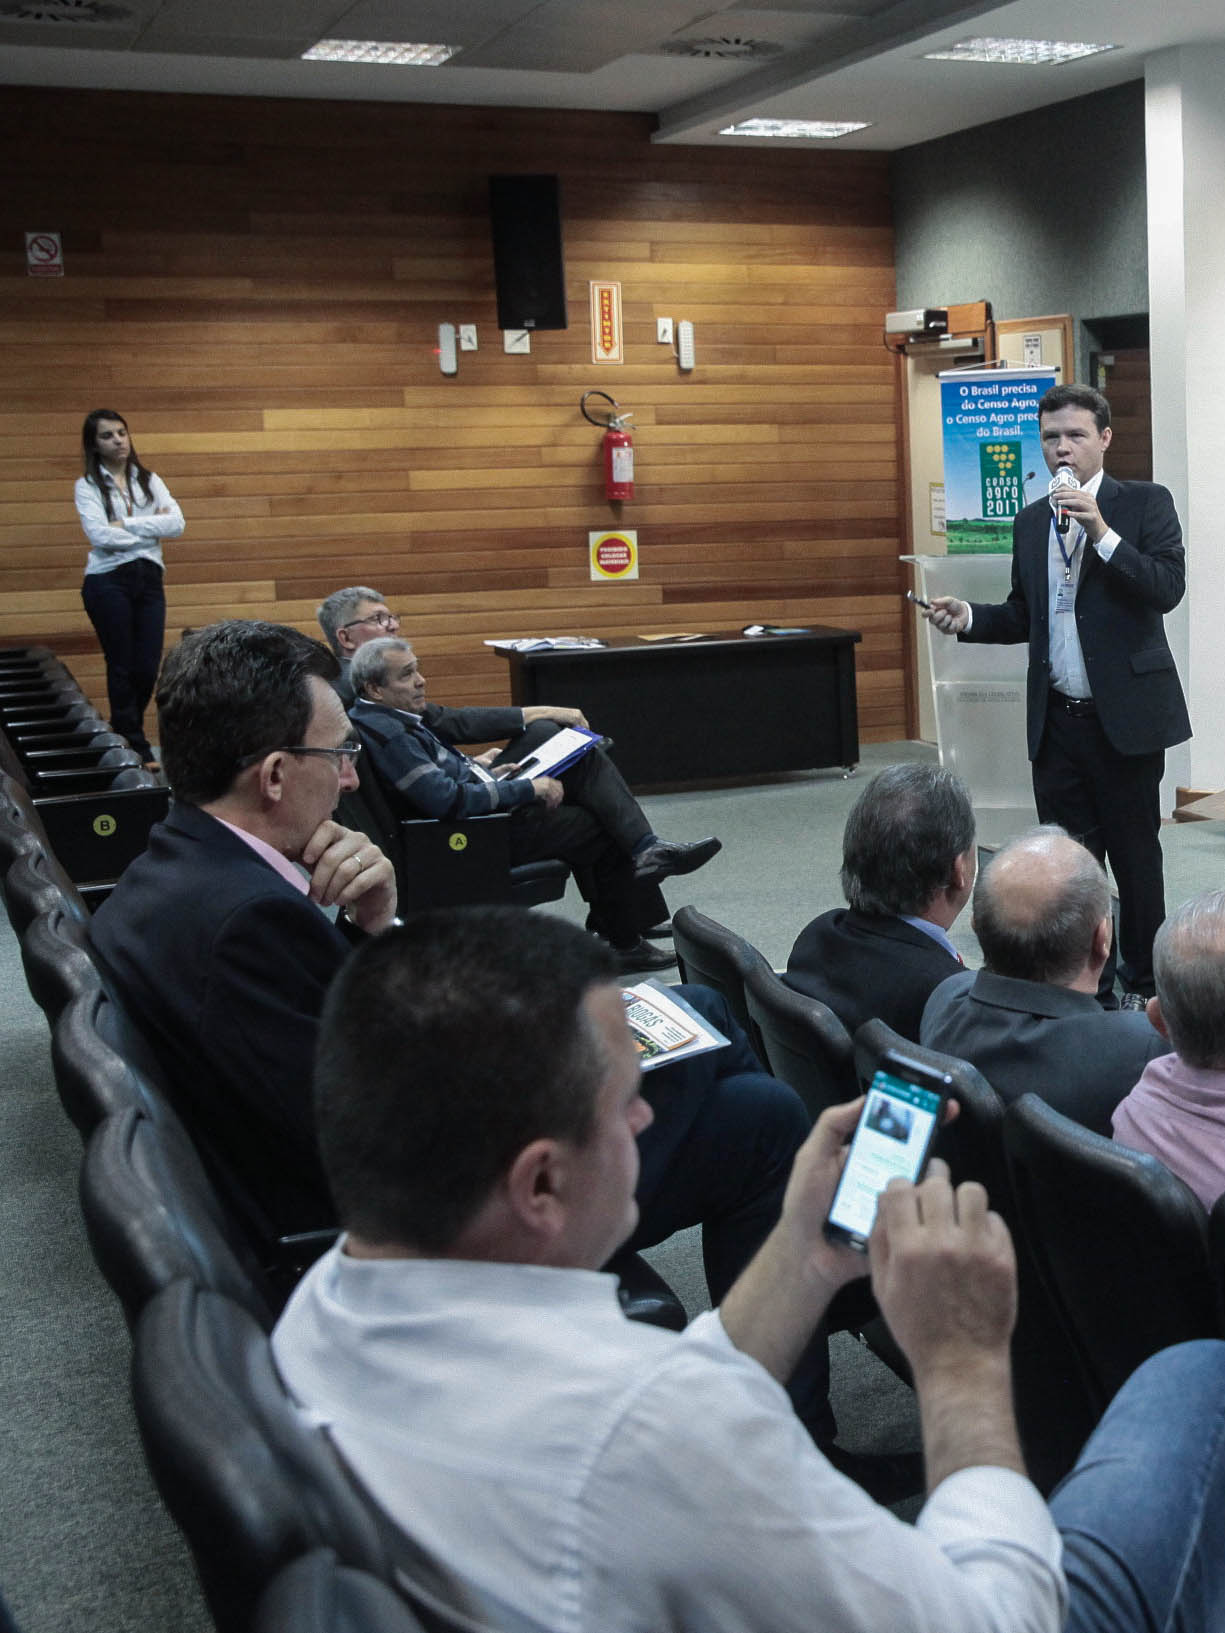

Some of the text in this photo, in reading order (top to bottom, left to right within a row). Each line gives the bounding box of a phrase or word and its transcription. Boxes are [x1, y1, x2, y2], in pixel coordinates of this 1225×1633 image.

[959, 383, 1037, 397] O Brasil precisa
[961, 397, 1039, 410] do Censo Agro,
[946, 412, 1039, 425] o Censo Agro prec
[976, 425, 1023, 438] do Brasil.
[985, 476, 1018, 486] censo
[986, 486, 1019, 499] agro
[986, 499, 1019, 516] 2017
[100, 820, 111, 831] B
[455, 837, 464, 847] A
